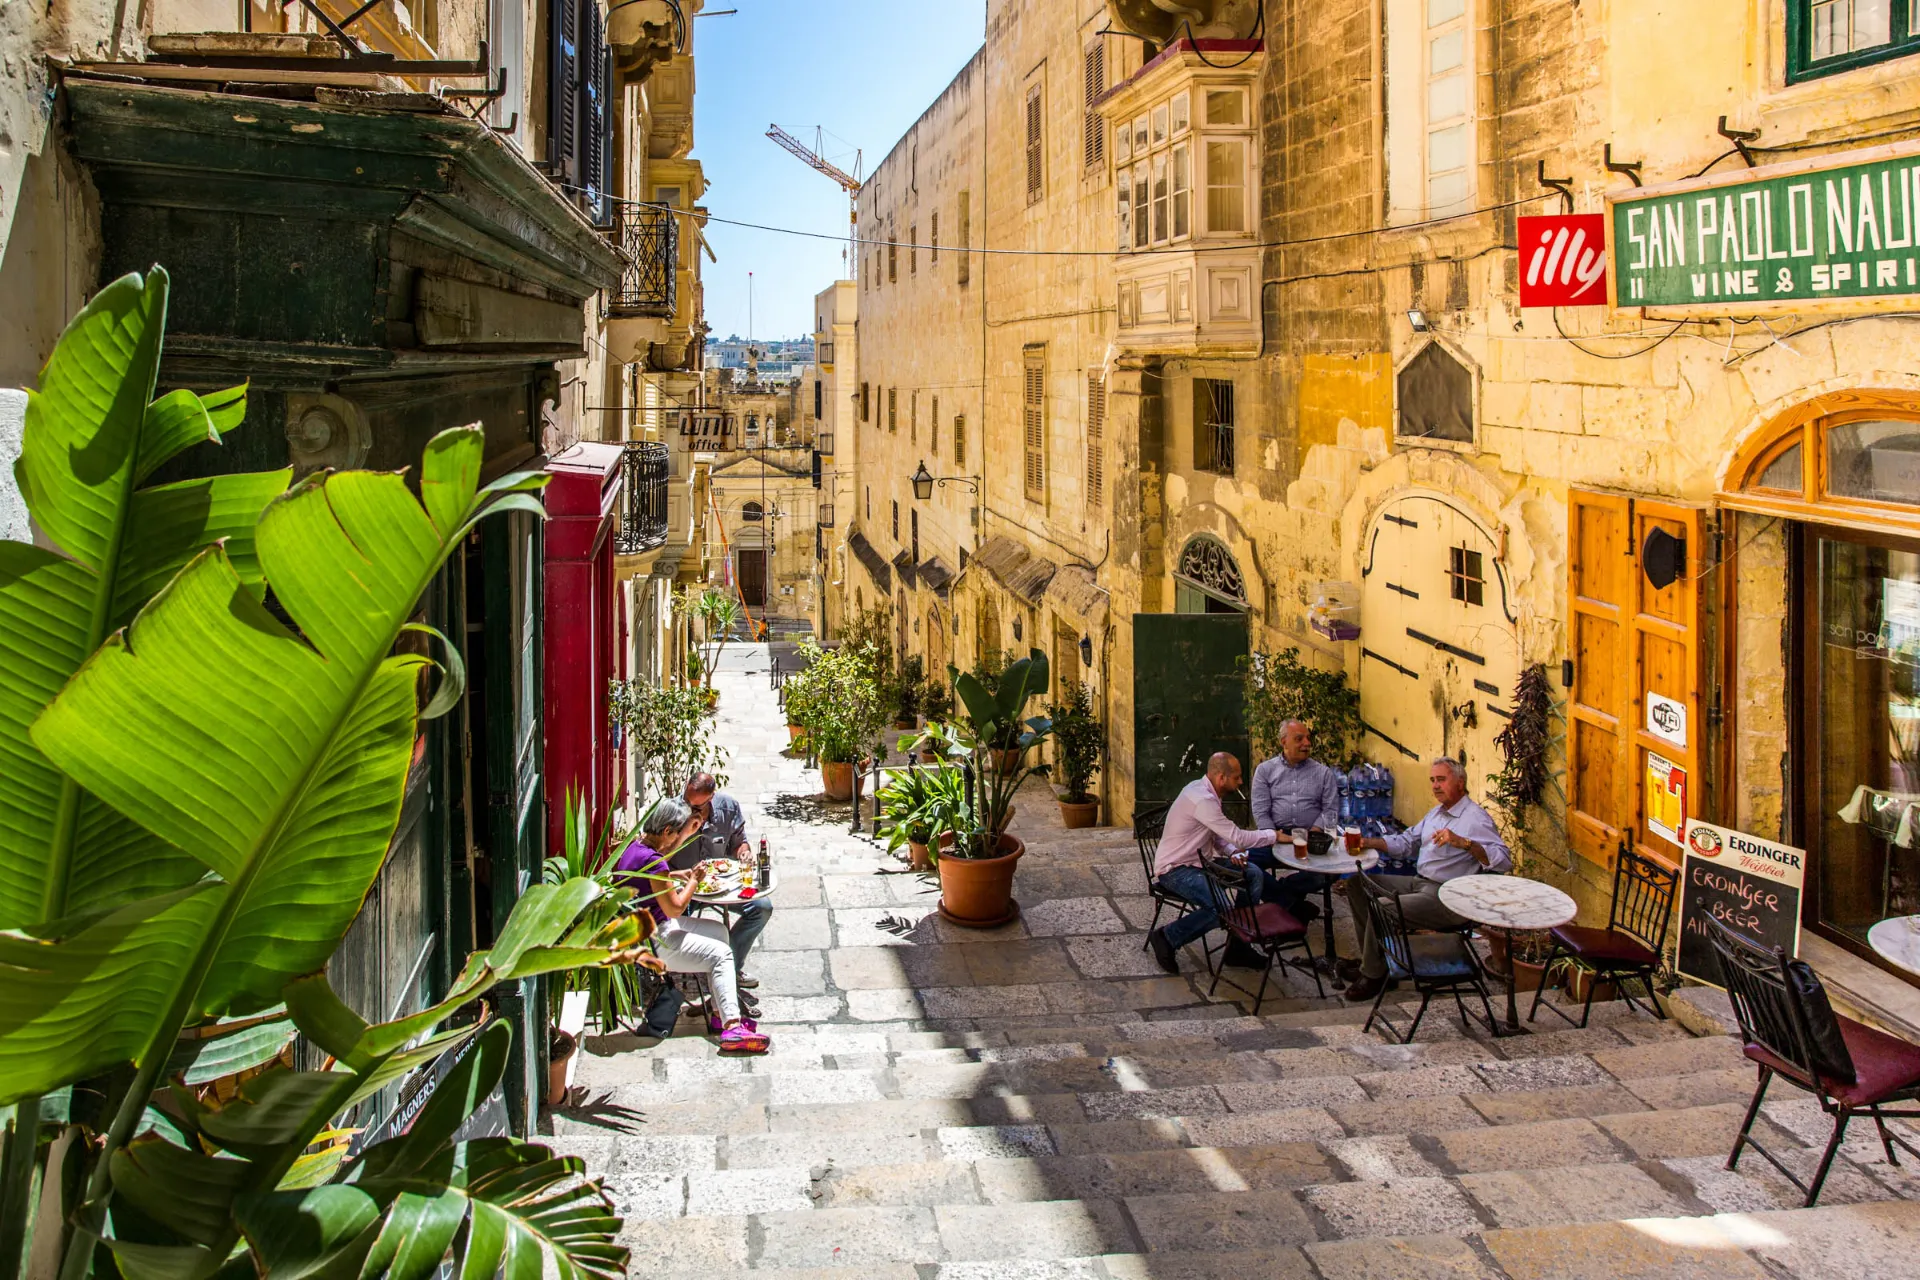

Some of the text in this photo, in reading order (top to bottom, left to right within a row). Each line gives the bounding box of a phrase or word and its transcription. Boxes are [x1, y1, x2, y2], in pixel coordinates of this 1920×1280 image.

[1627, 202, 1685, 269] SAN
[1696, 184, 1814, 264] PAOLO
[1526, 226, 1605, 298] illy
[1691, 269, 1759, 297] WINE
[1774, 267, 1794, 293] &
[1729, 835, 1800, 870] ERDINGER
[1740, 855, 1785, 878] Weißbier
[1693, 867, 1779, 912] ERDINGER
[1712, 900, 1764, 934] BEER
[389, 1074, 438, 1139] MAGNERS
